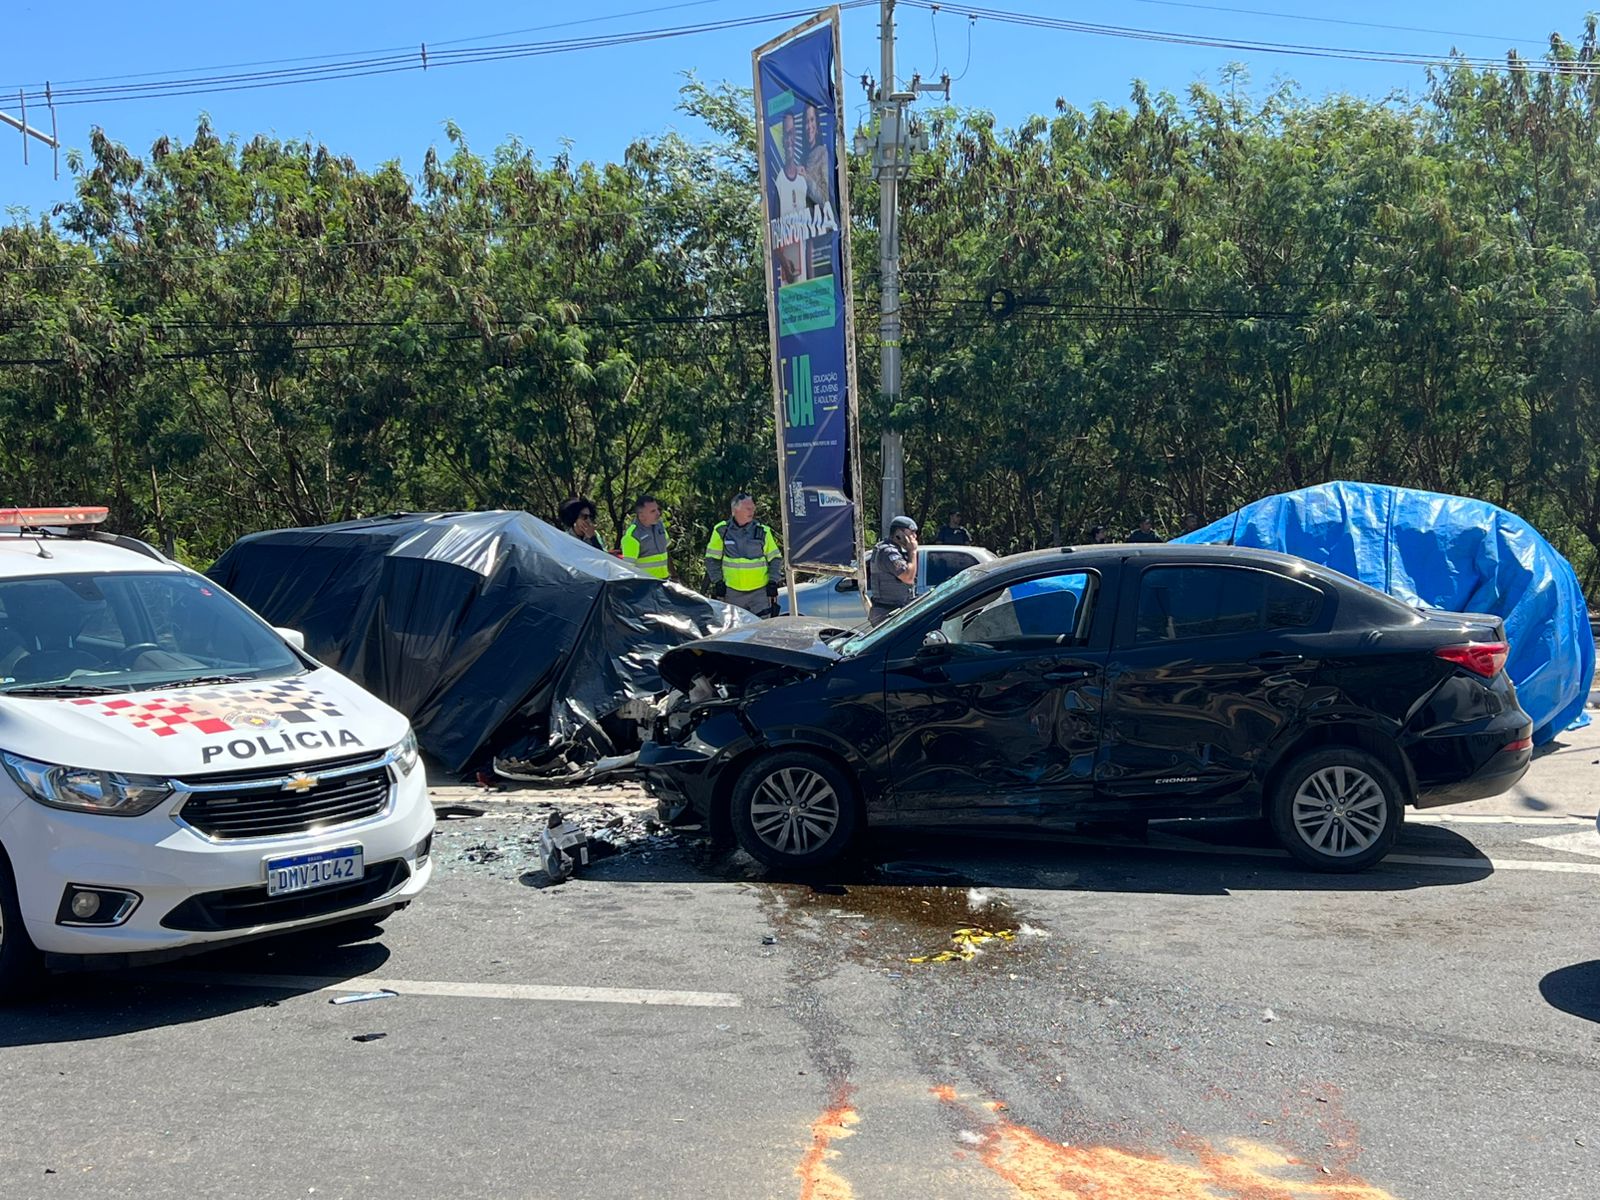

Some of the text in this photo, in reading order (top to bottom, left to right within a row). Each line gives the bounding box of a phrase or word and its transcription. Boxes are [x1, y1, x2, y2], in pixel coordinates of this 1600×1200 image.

[814, 372, 837, 383] EDUCAÇÃO
[820, 384, 838, 393] JOVENS
[201, 729, 365, 764] POLÍCIA
[278, 858, 354, 889] DMV1C42
